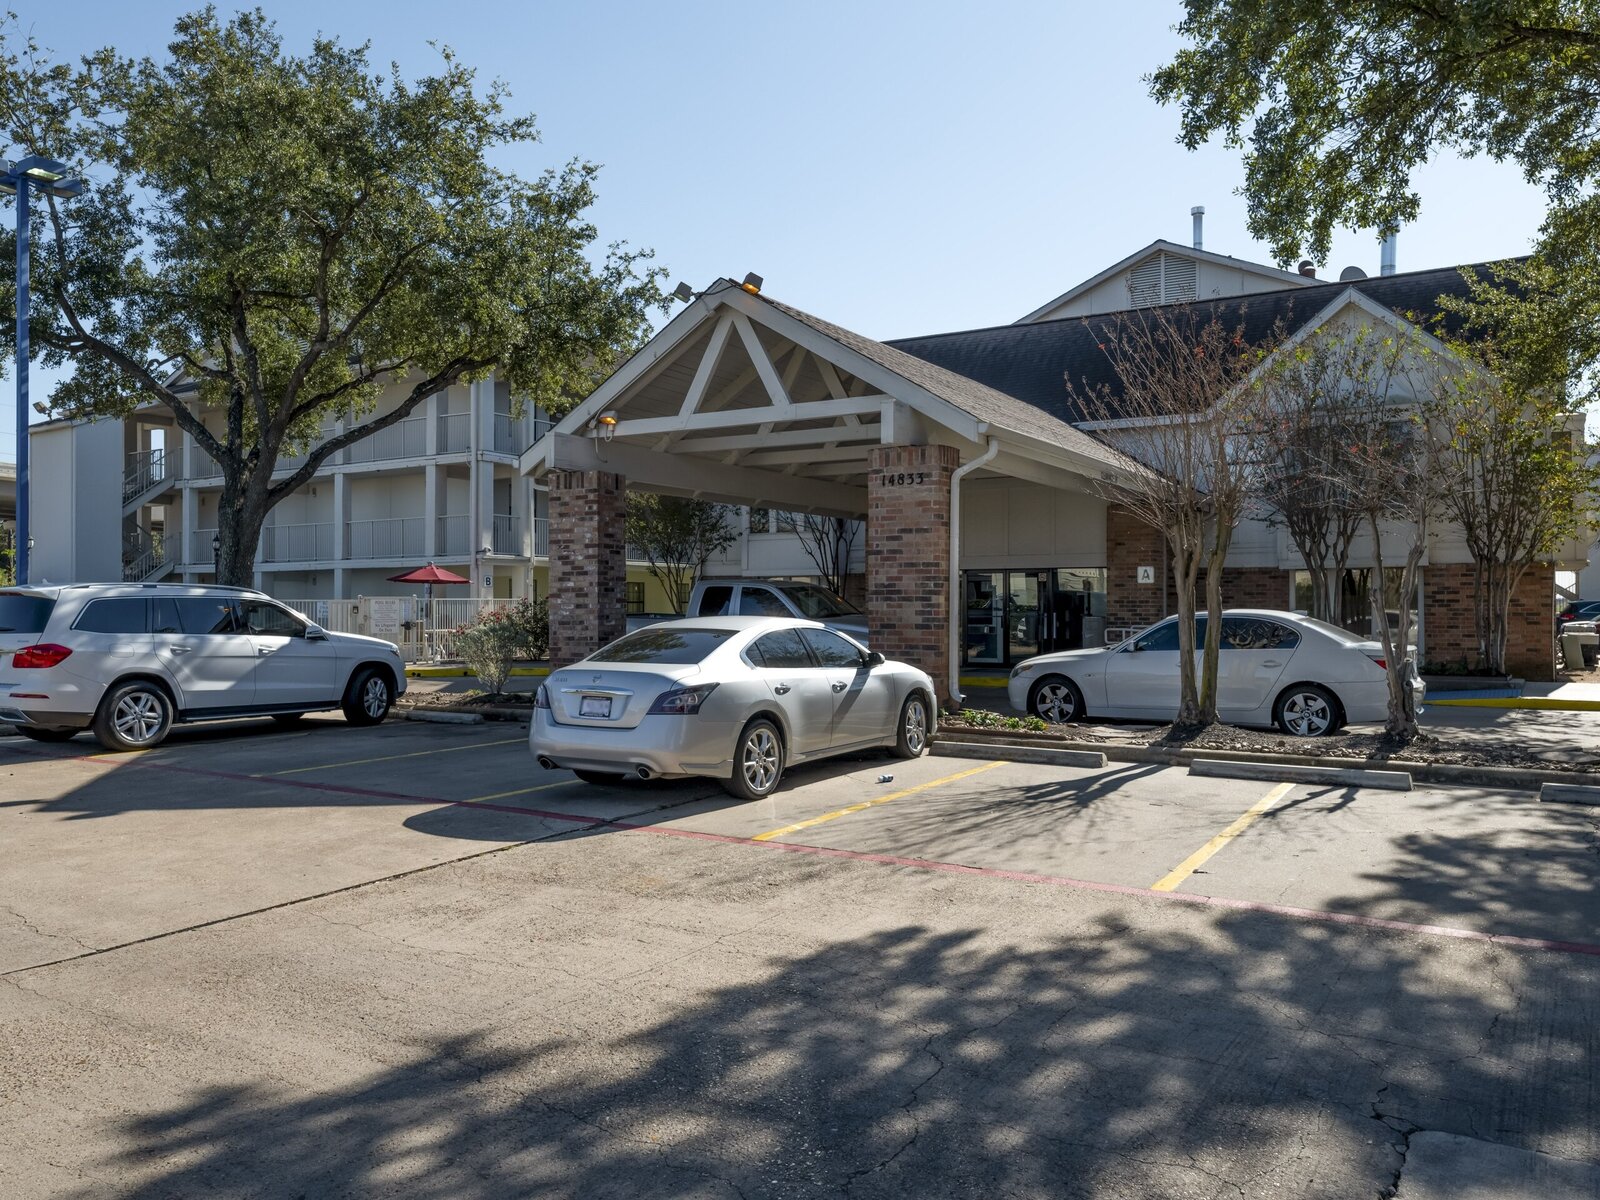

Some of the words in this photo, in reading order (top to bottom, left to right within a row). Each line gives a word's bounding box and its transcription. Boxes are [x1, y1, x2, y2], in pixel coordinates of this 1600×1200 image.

[882, 472, 924, 486] 14833
[1142, 568, 1150, 580] A
[486, 576, 491, 586] B
